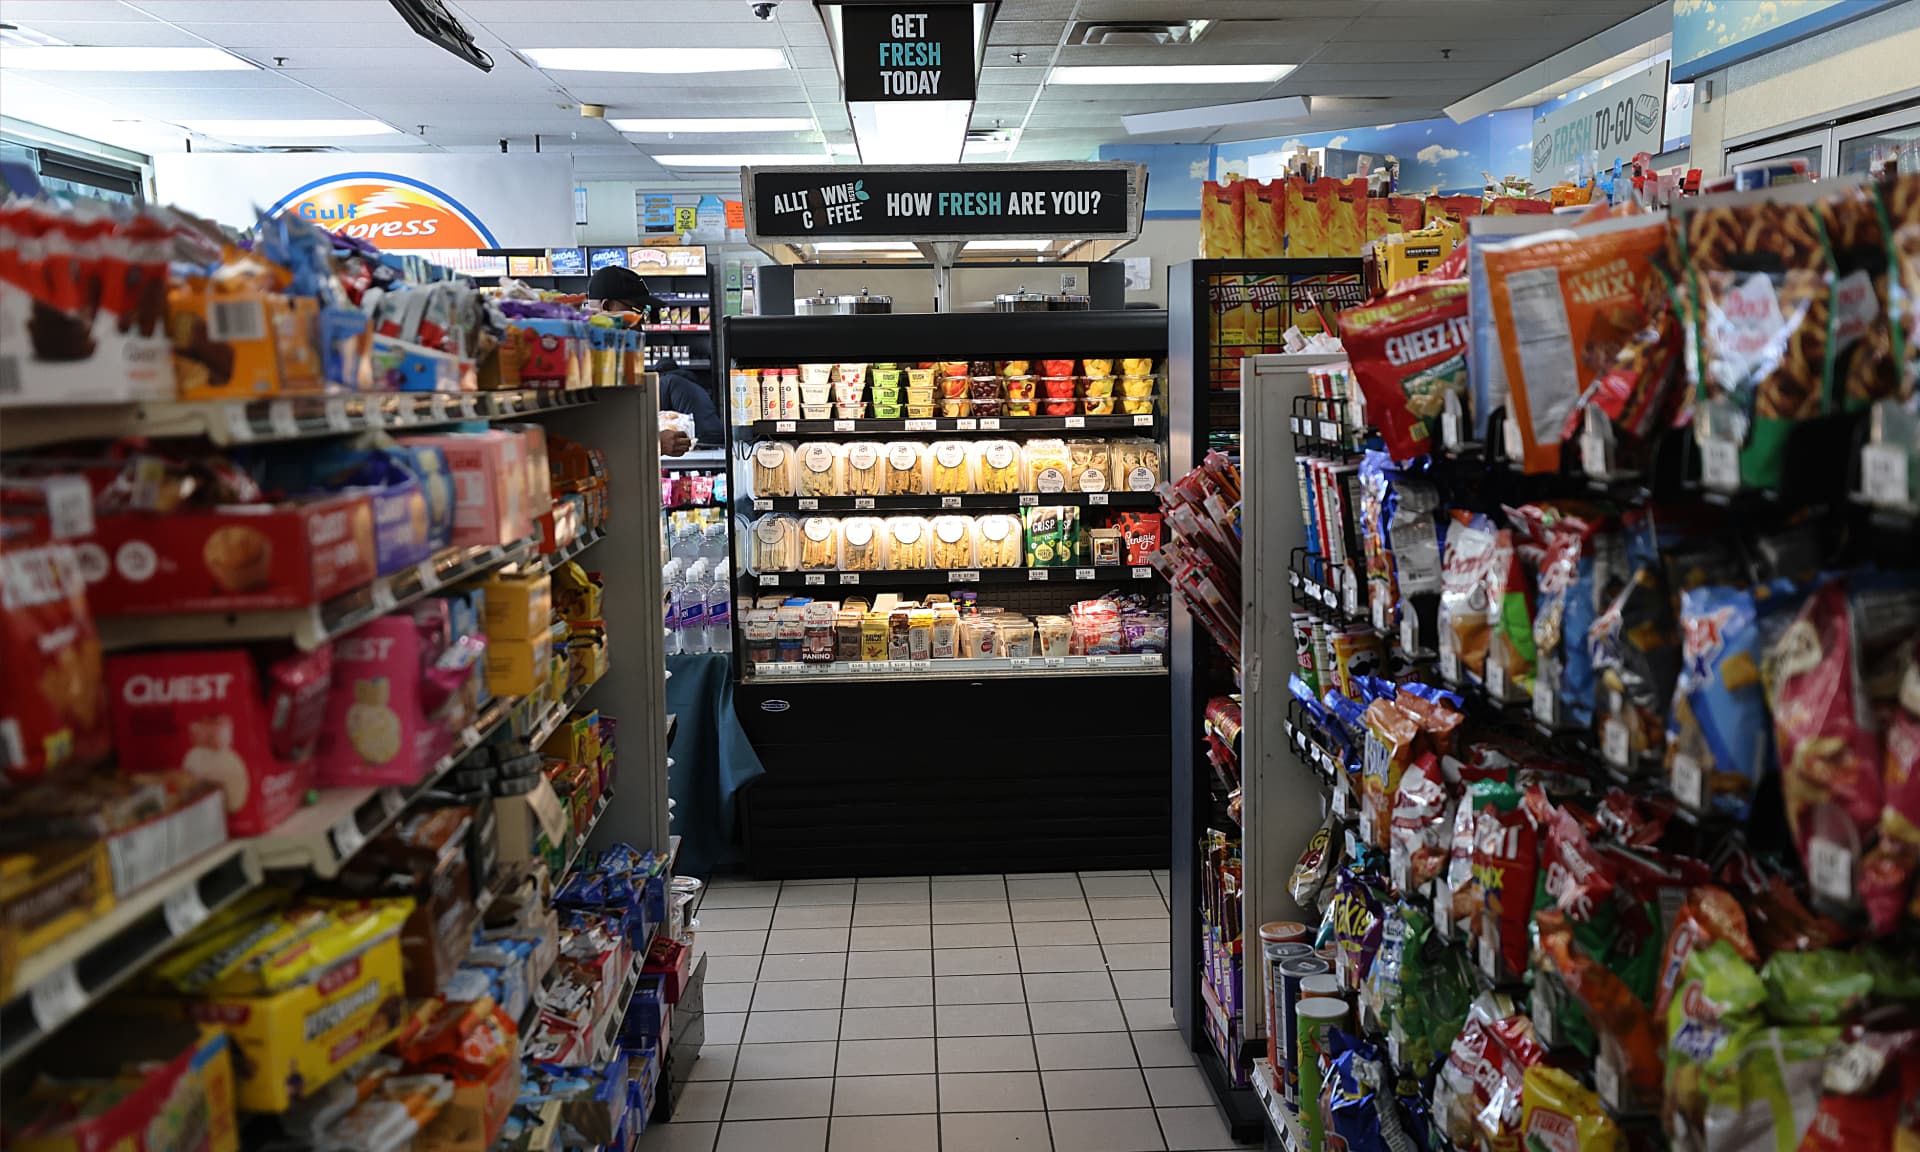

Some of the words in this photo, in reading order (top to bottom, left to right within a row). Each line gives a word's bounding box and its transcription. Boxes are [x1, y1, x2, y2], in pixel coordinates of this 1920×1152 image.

[891, 14, 928, 38] GET
[880, 42, 941, 67] FRESH
[880, 71, 941, 95] TODAY
[1552, 115, 1593, 167] FRESH
[1595, 97, 1633, 150] TO-GO
[299, 202, 358, 219] Gulf
[887, 192, 932, 217] HOW
[939, 192, 1001, 216] FRESH
[1008, 191, 1046, 216] ARE
[1051, 190, 1101, 215] YOU?
[335, 638, 393, 660] UEST
[122, 672, 232, 704] QUEST
